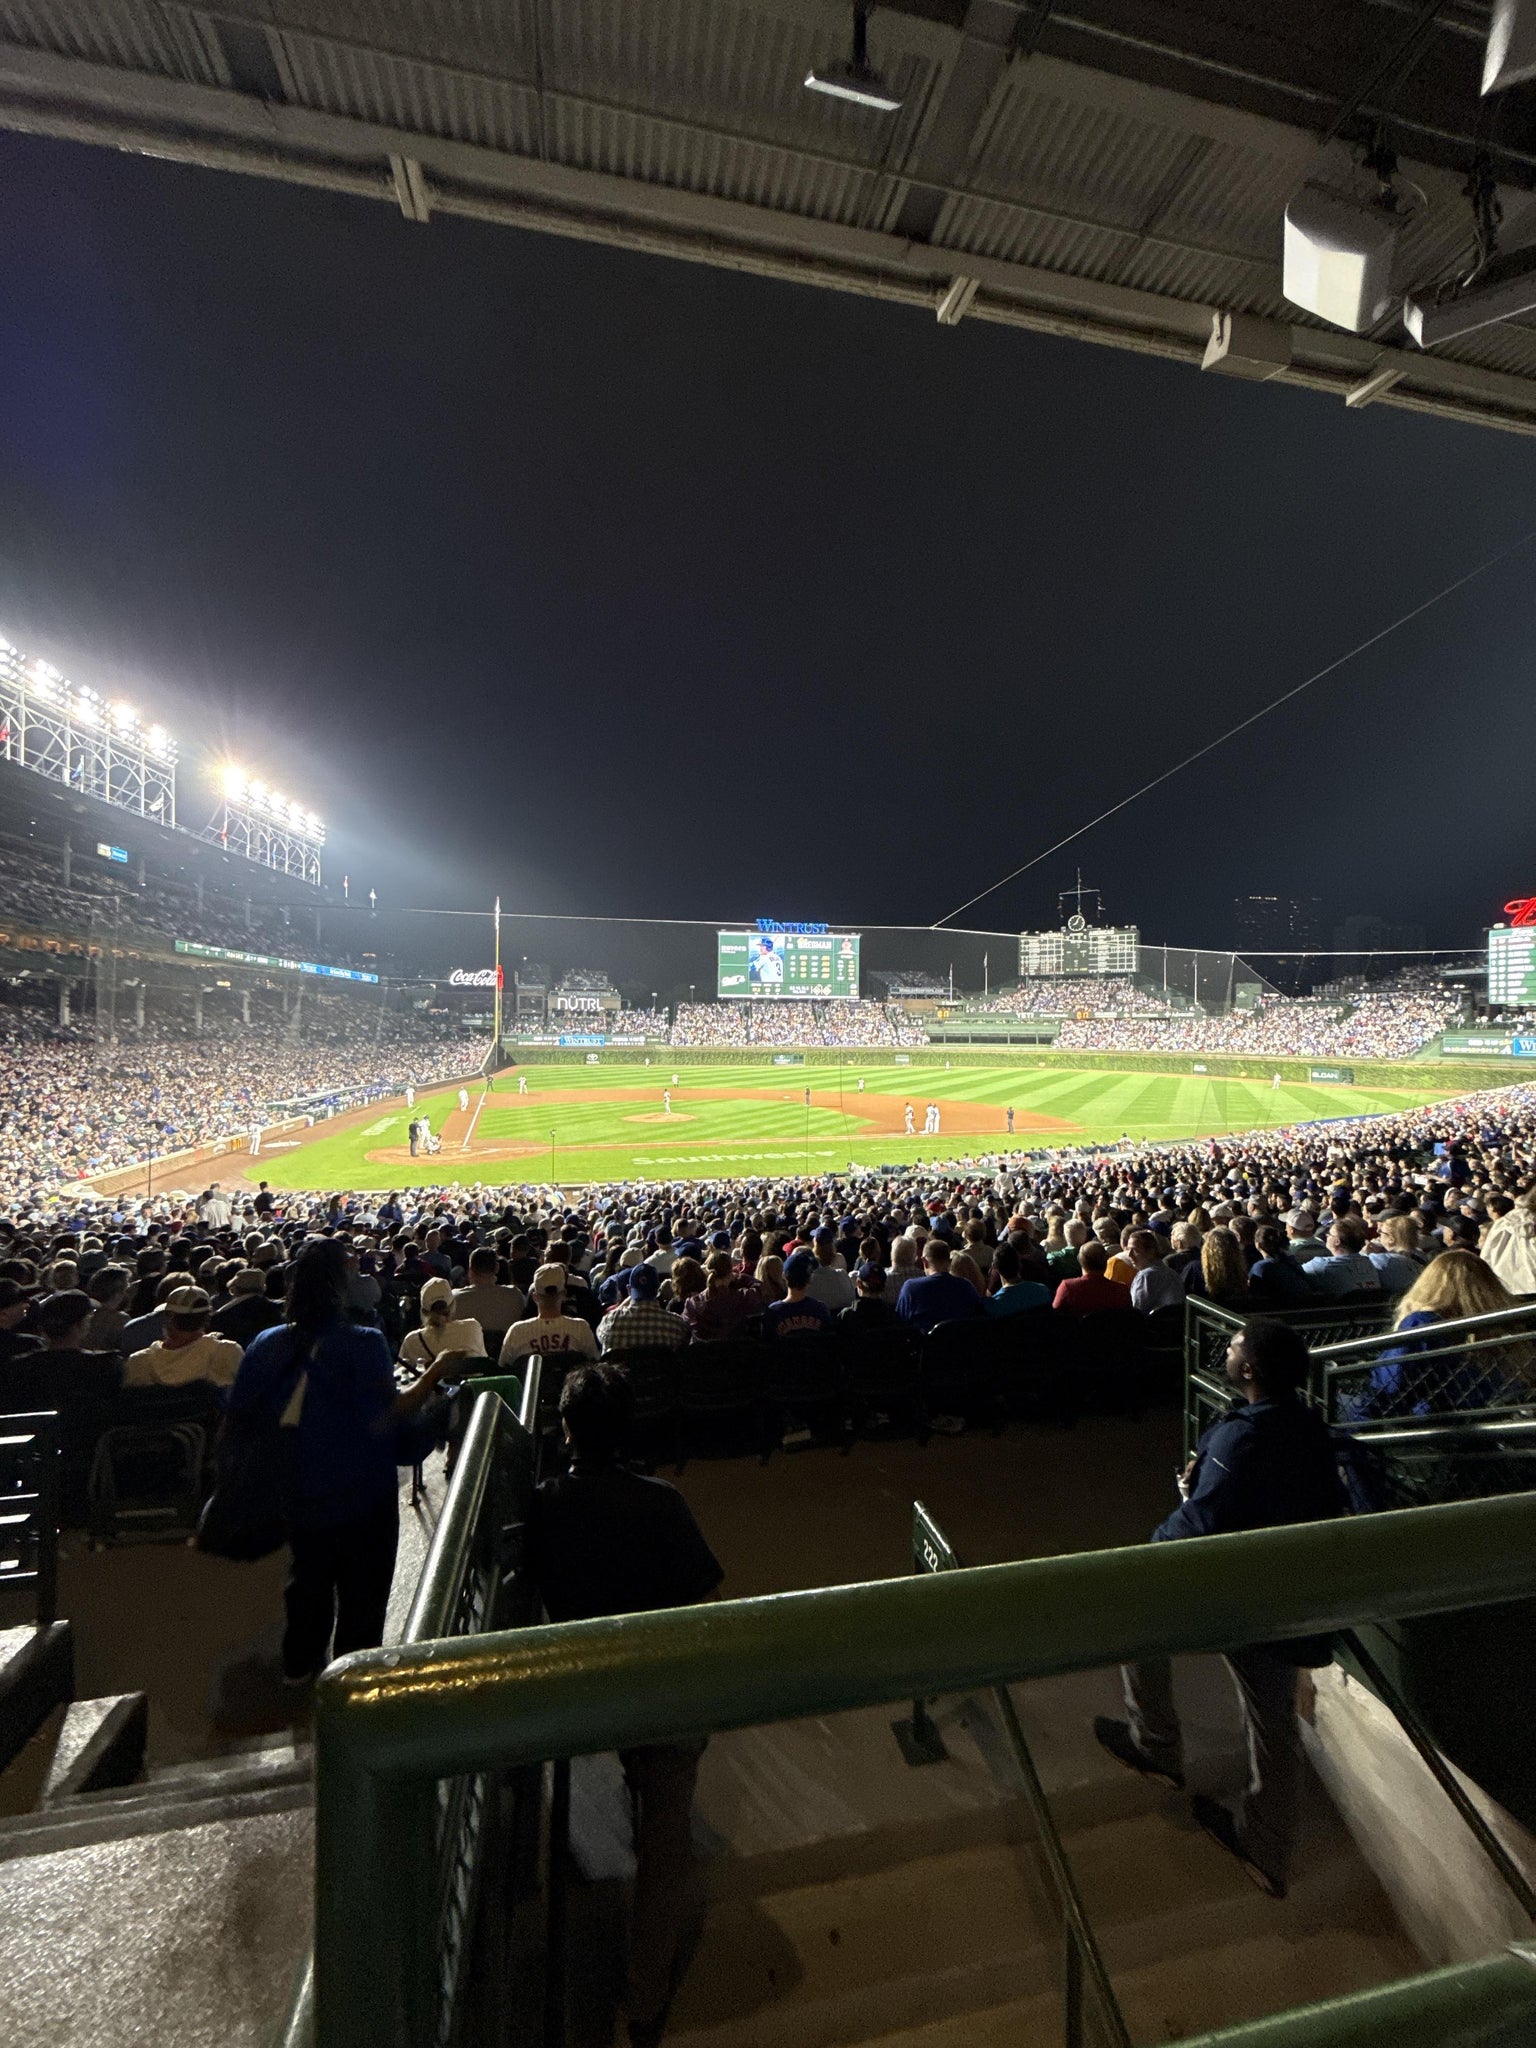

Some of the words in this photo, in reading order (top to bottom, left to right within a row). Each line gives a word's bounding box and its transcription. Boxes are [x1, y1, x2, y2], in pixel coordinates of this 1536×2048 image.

[756, 919, 828, 934] WINTRUST
[632, 1150, 816, 1165] Southwest
[529, 1334, 571, 1354] SOSA
